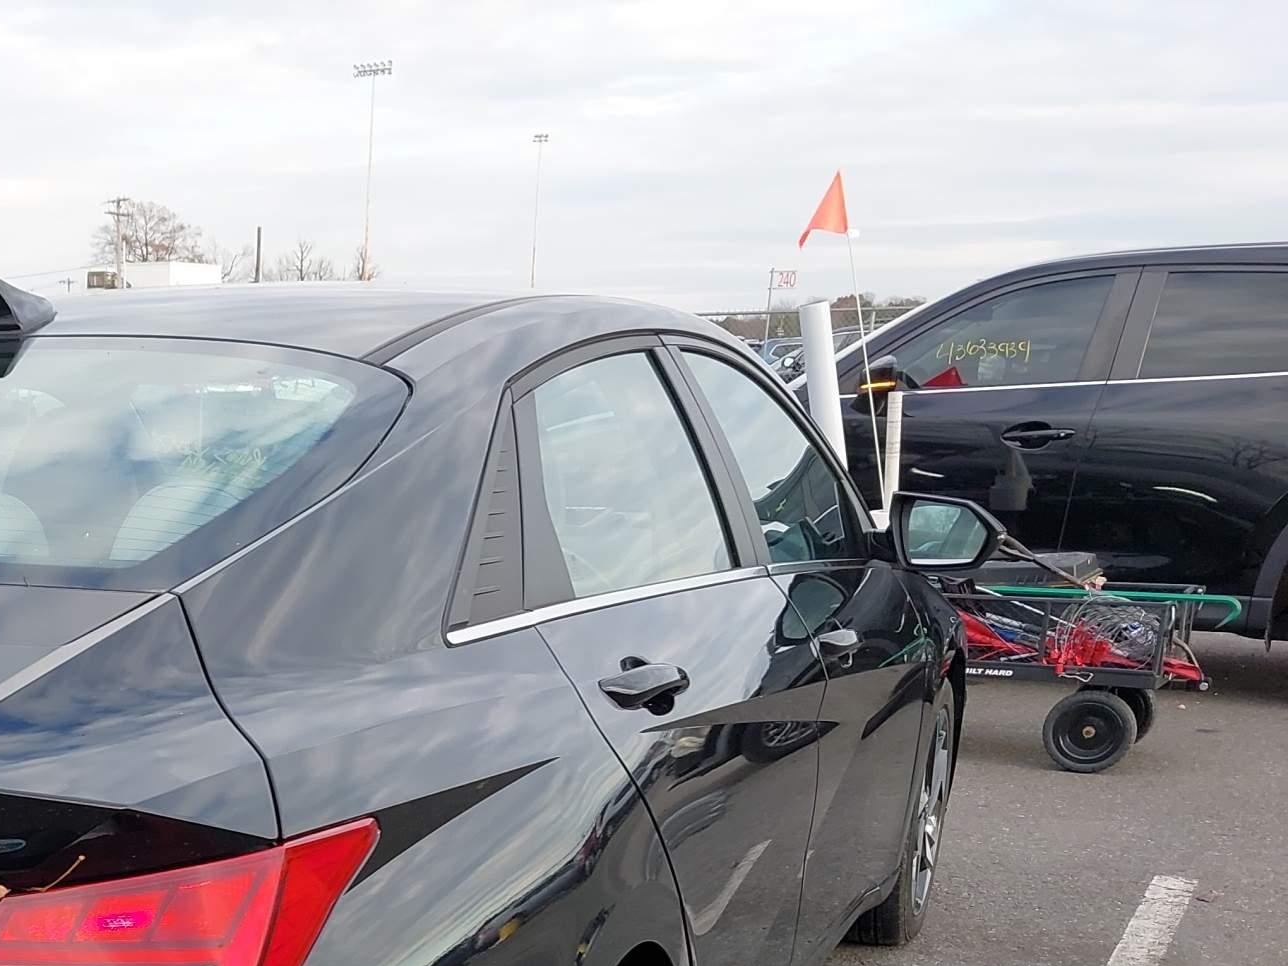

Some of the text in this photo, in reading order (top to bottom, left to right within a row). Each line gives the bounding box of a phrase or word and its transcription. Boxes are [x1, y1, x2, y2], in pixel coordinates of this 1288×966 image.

[778, 271, 797, 288] 240
[936, 338, 1031, 365] 43633939
[984, 668, 1013, 677] HARD
